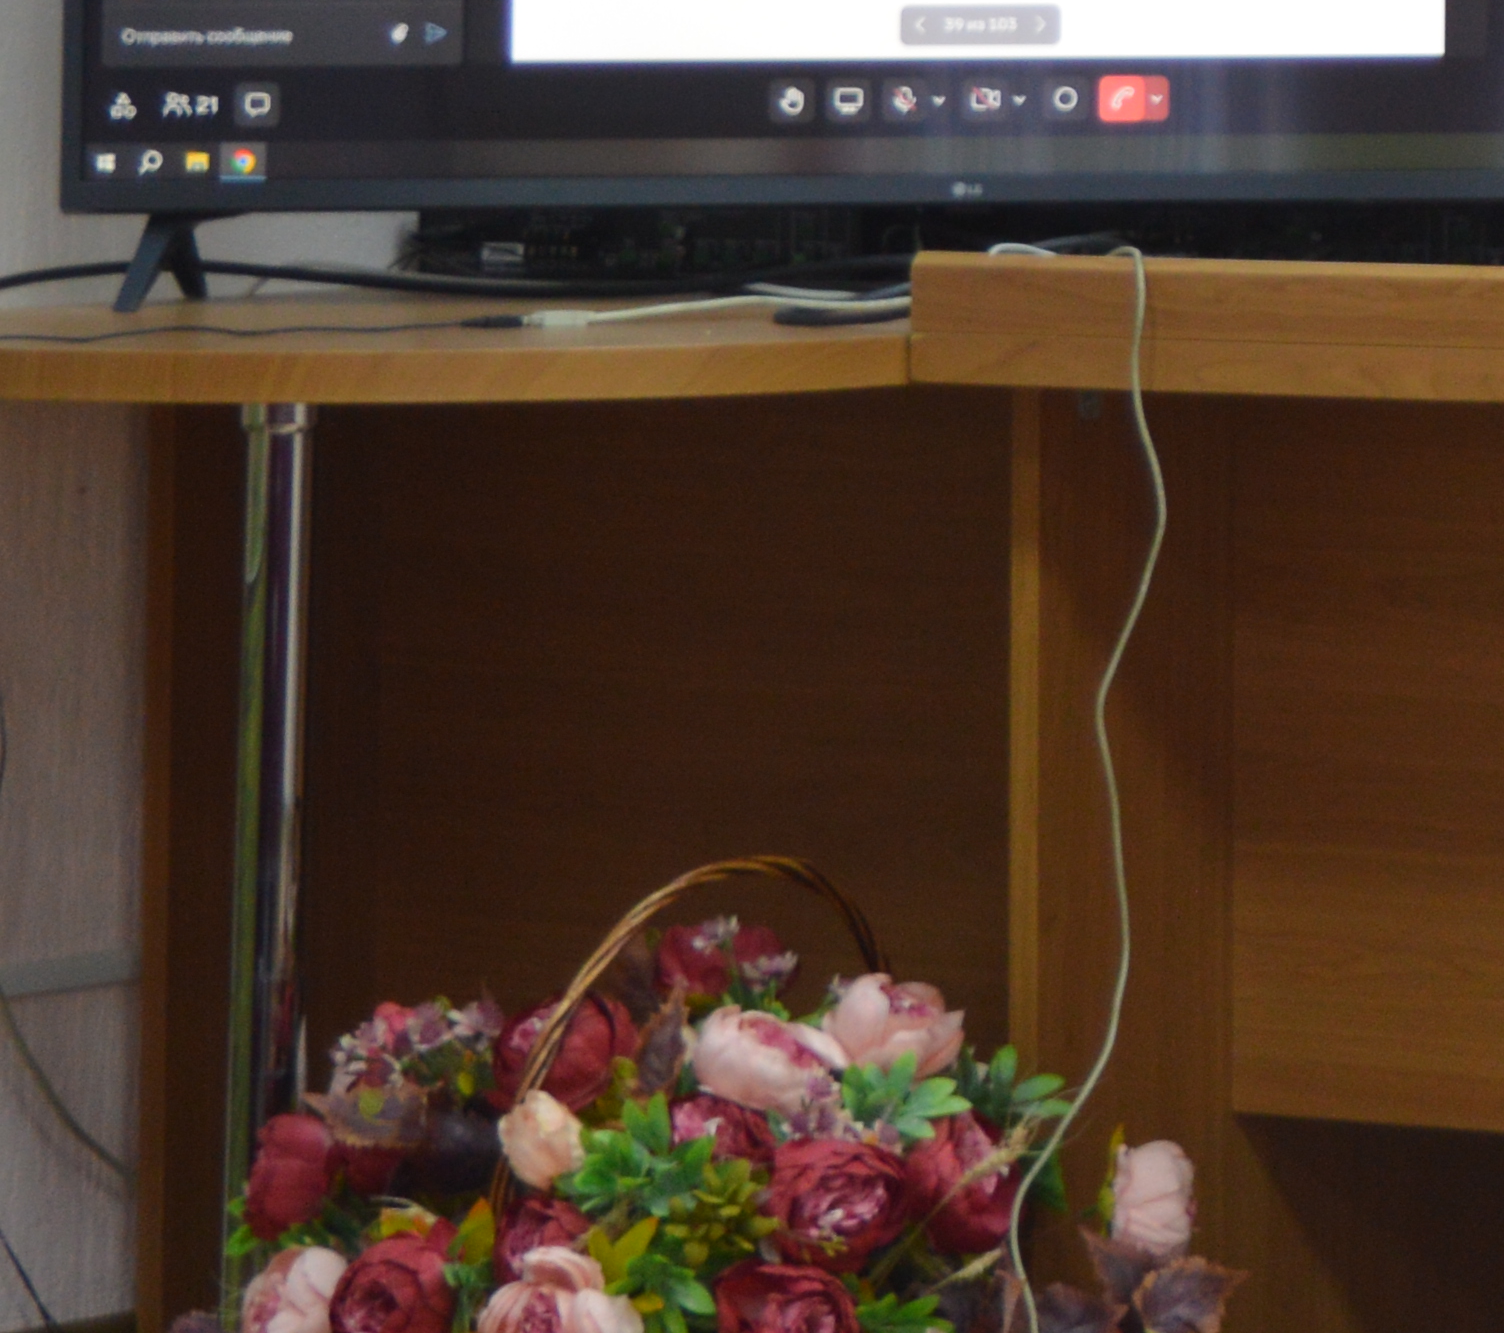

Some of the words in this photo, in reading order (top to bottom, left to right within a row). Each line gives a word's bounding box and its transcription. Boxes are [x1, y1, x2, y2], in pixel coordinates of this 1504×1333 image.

[967, 20, 985, 32] из
[121, 28, 206, 45] Отправить
[206, 27, 293, 45] сообщение
[195, 96, 218, 115] 21
